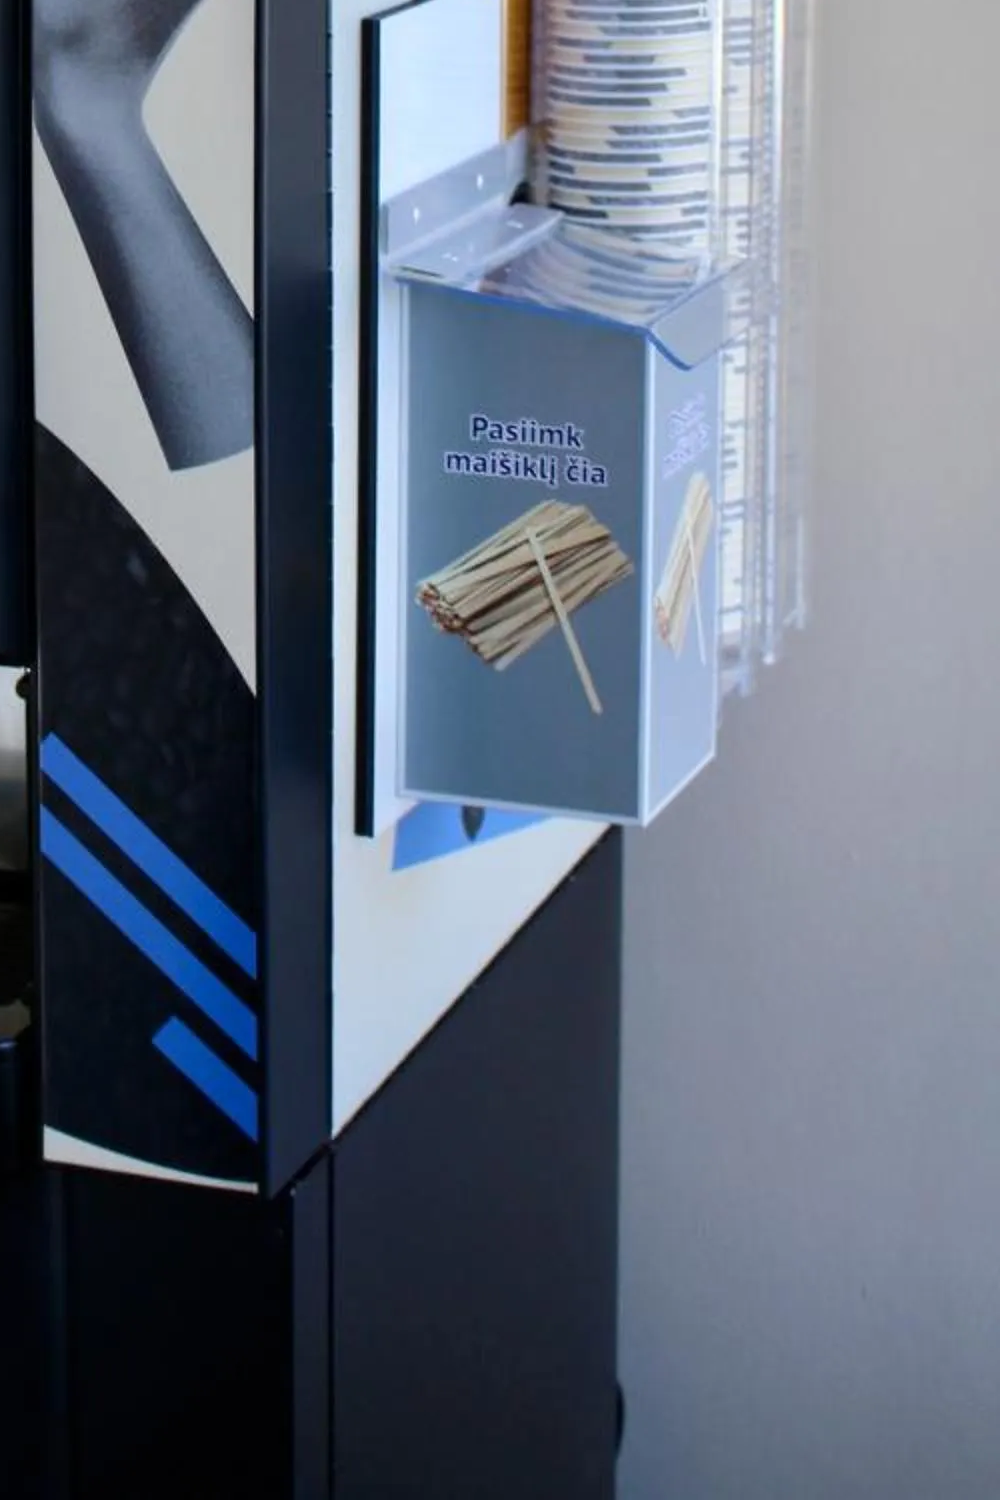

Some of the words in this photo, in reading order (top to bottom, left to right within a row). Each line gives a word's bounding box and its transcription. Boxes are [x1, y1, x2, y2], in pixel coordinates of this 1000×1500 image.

[469, 413, 585, 450] Pasiimk
[444, 449, 558, 486] maišiklį
[566, 451, 608, 488] čia
